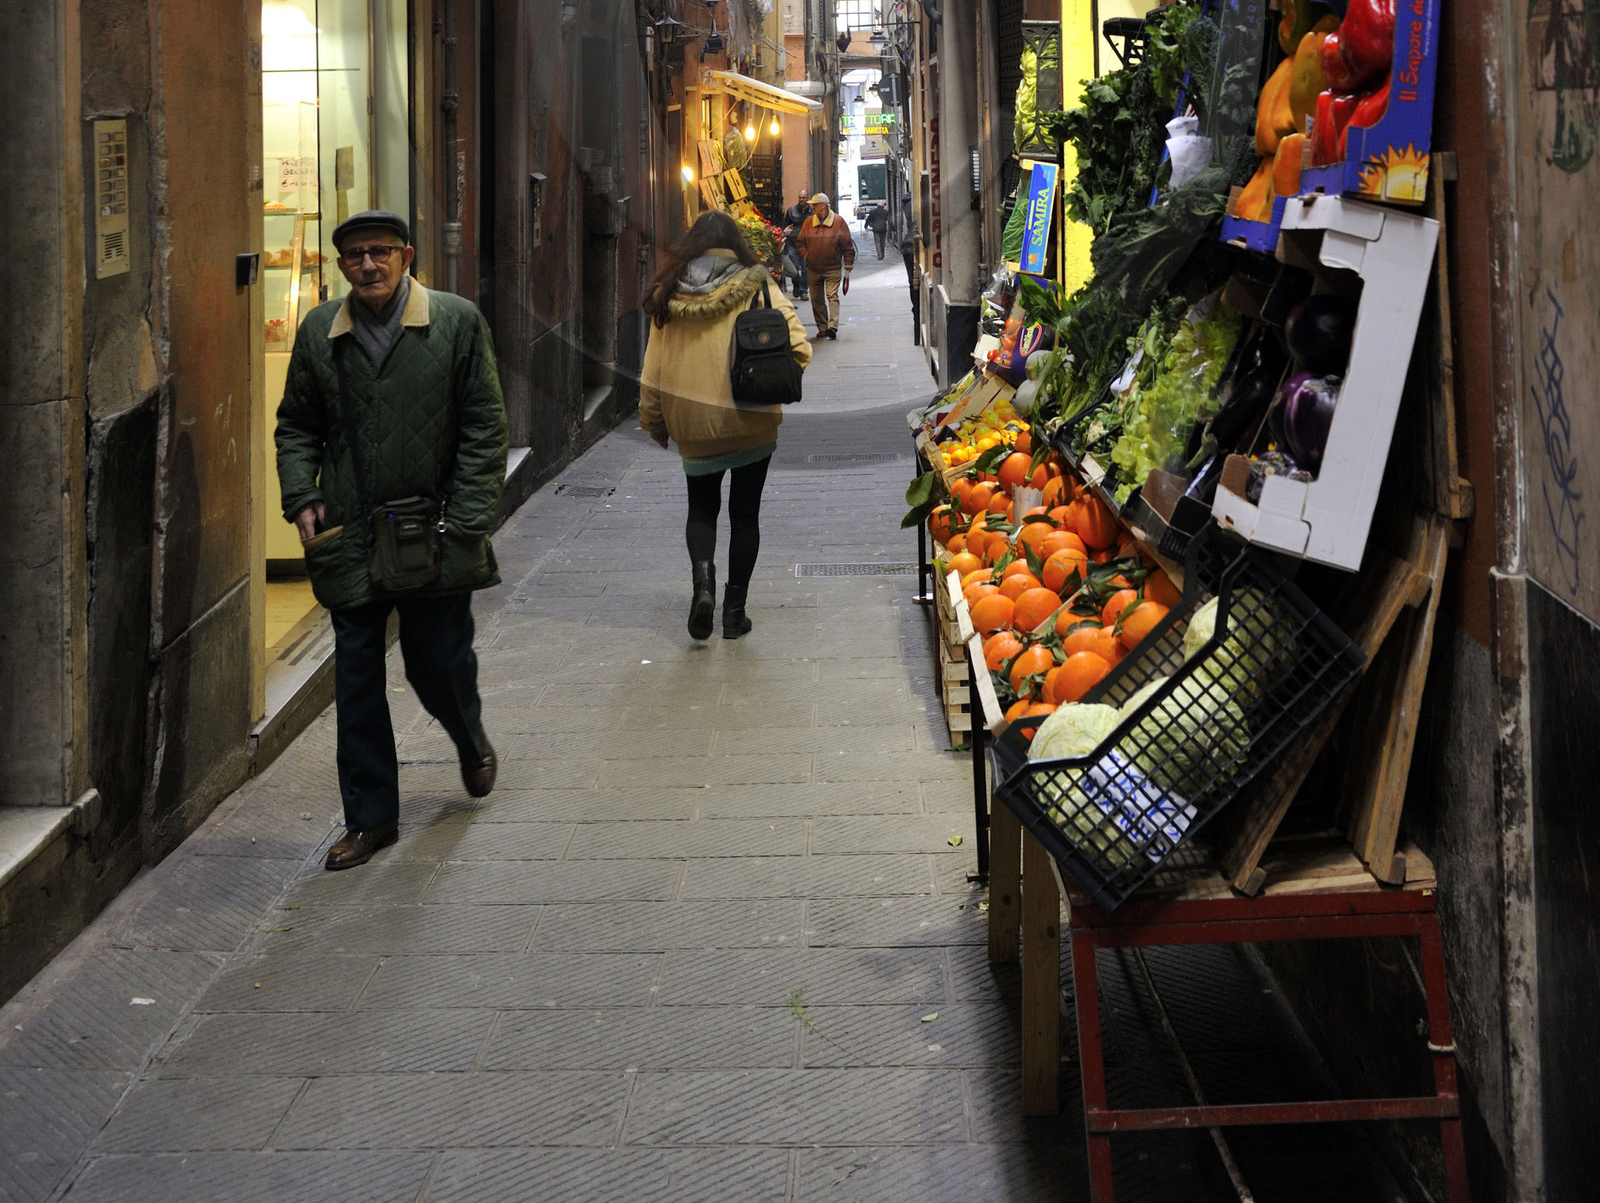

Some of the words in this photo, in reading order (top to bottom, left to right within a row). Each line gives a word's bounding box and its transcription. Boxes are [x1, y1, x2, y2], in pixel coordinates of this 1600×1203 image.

[1399, 20, 1425, 86] Sapore
[1398, 89, 1418, 102] Il
[1030, 187, 1050, 247] SAMIRA
